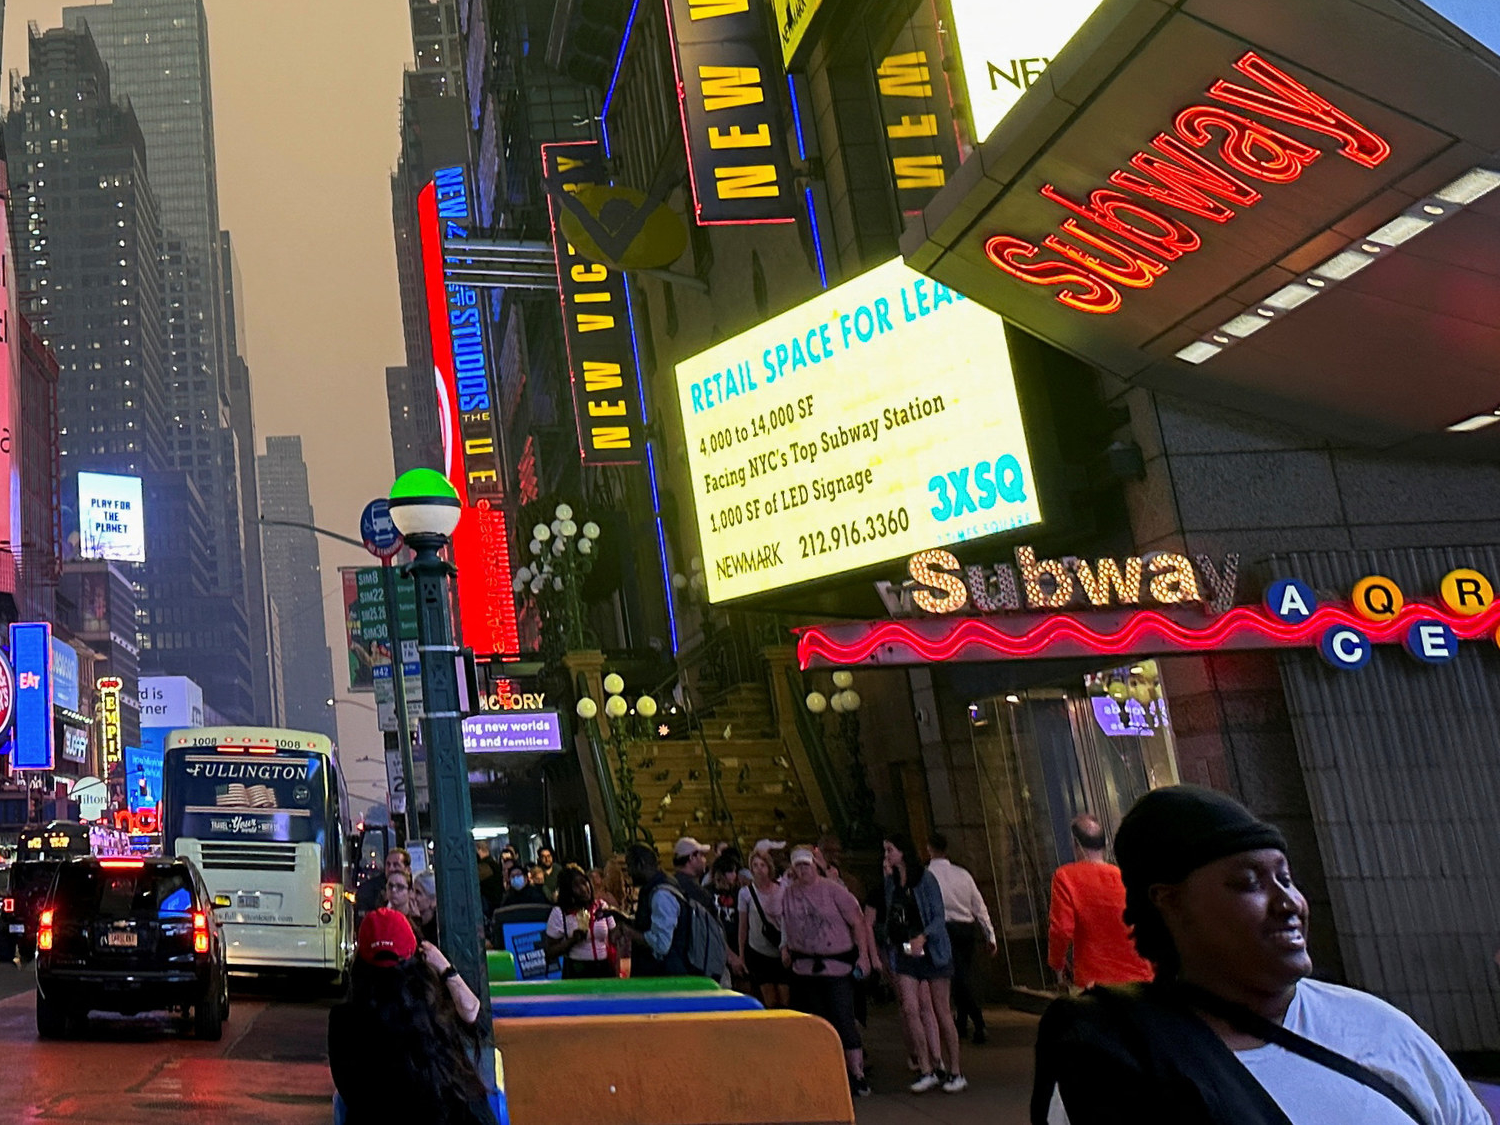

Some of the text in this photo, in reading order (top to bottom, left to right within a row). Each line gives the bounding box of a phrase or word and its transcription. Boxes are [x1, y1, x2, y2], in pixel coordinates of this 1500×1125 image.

[700, 65, 782, 200] NEW
[435, 167, 467, 215] NEW
[984, 51, 1391, 314] Subway
[449, 307, 489, 411] STUDIOS
[691, 297, 893, 414] RETAIL SPACE FOR
[584, 361, 632, 451] NEW
[700, 395, 814, 457] 4,000 to 14,000 SF
[704, 395, 946, 494] Facing NYC's Top Subway Station
[91, 498, 131, 510] PLAY FOR
[710, 468, 873, 533] 1,000 SF of LED Signage
[928, 453, 1027, 522] 3XSQ
[95, 523, 128, 533] PLANET
[104, 511, 119, 521] THE
[799, 508, 910, 560] 212.916.3360
[716, 542, 784, 581] NEWMARK
[360, 588, 384, 603] SIM22
[911, 546, 1241, 616] Subway
[1280, 579, 1485, 616] A Q R
[1333, 626, 1449, 662] C E
[373, 667, 388, 678] M42
[153, 688, 163, 700] is
[193, 737, 300, 749] 1008 1008
[480, 736, 501, 747] and
[503, 737, 549, 746] families
[485, 720, 550, 733] new worlds
[186, 764, 308, 780] FULLINGTON
[232, 816, 257, 833] Your
